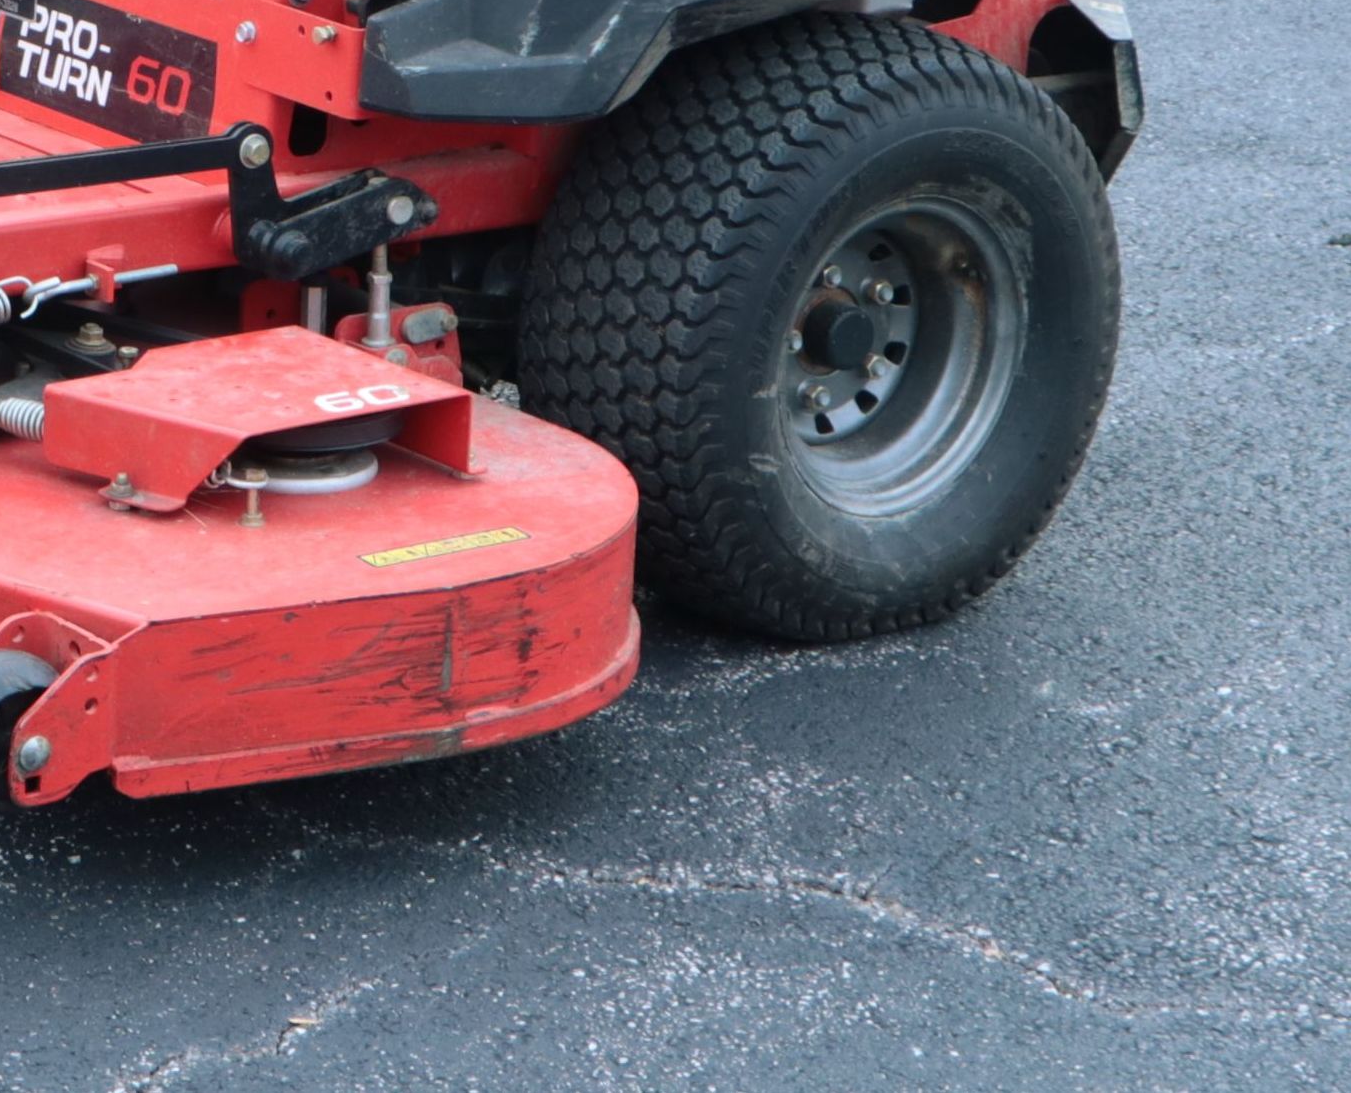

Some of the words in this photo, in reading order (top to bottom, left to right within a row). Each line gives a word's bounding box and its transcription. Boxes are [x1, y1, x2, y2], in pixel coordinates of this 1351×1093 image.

[21, 6, 111, 59] PRO-
[17, 41, 112, 107] TURN
[128, 56, 191, 115] 60
[315, 384, 410, 412] 60
